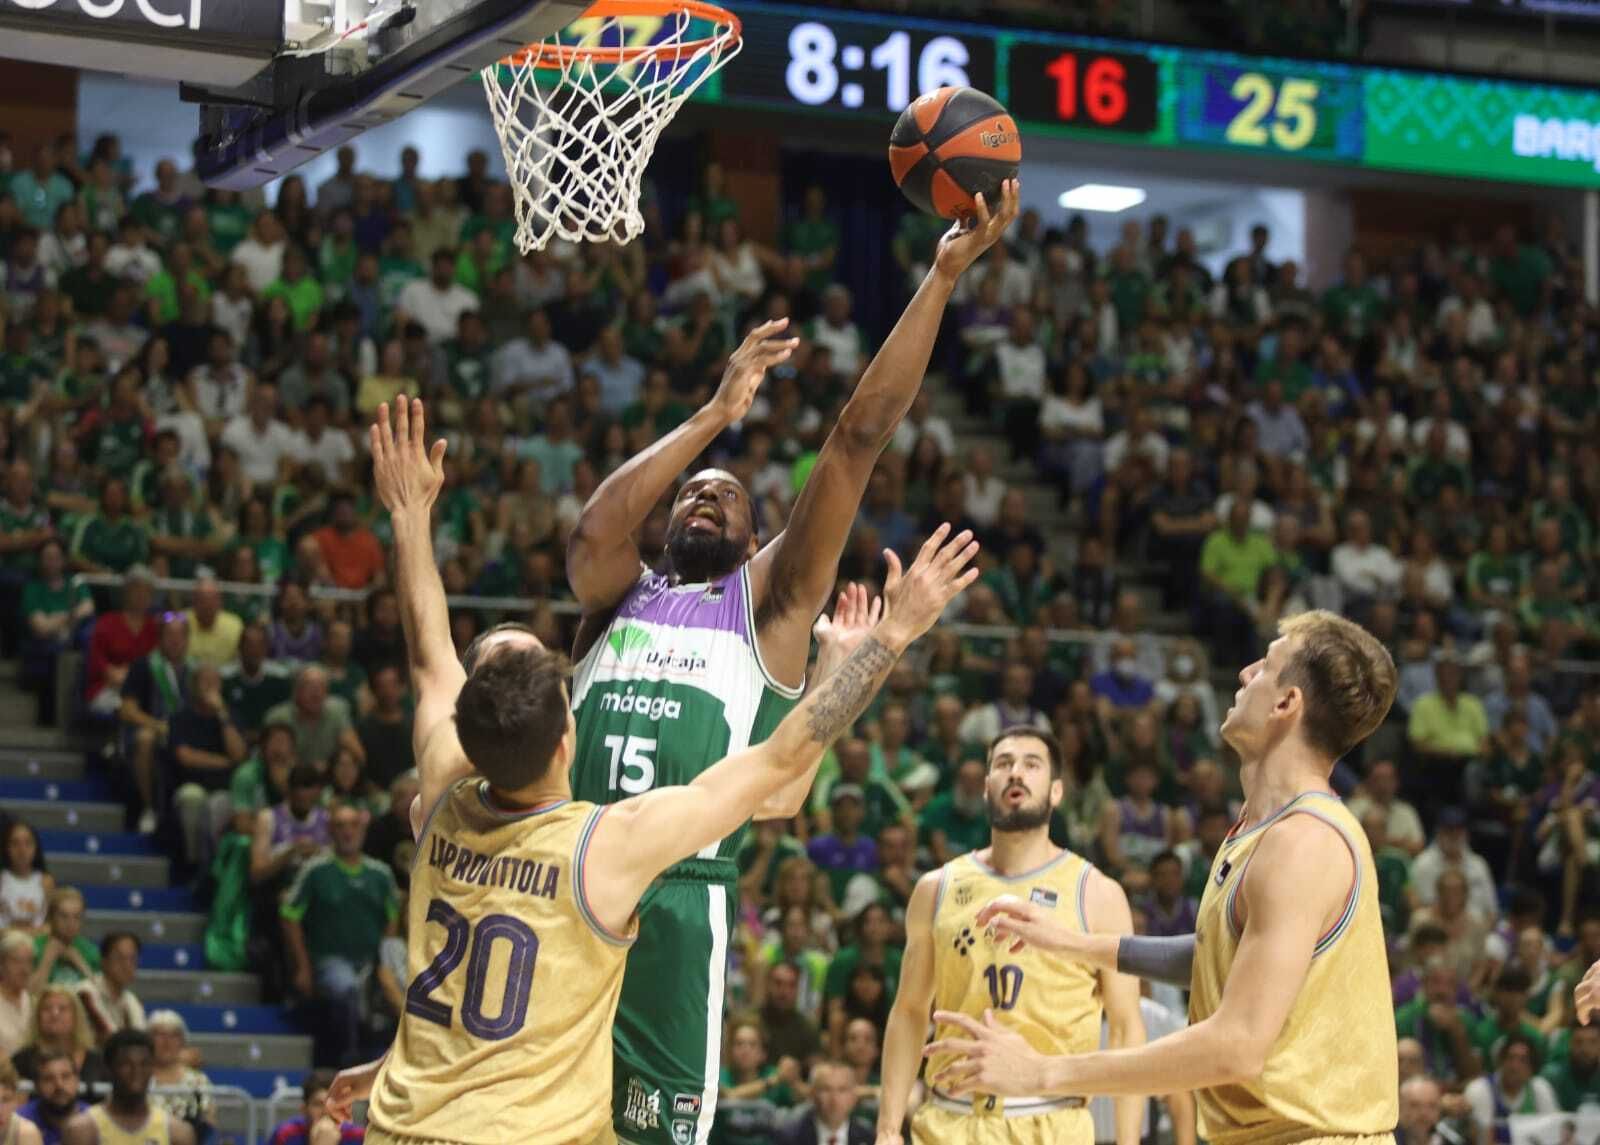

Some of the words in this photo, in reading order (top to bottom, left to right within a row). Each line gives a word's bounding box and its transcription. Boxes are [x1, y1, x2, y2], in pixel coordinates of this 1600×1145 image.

[785, 21, 973, 113] 8:16
[1046, 52, 1129, 125] 16
[1226, 73, 1319, 150] 25
[600, 685, 682, 721] máaga
[604, 734, 657, 794] 15
[406, 898, 540, 1041] 20
[983, 963, 1024, 1010] 10
